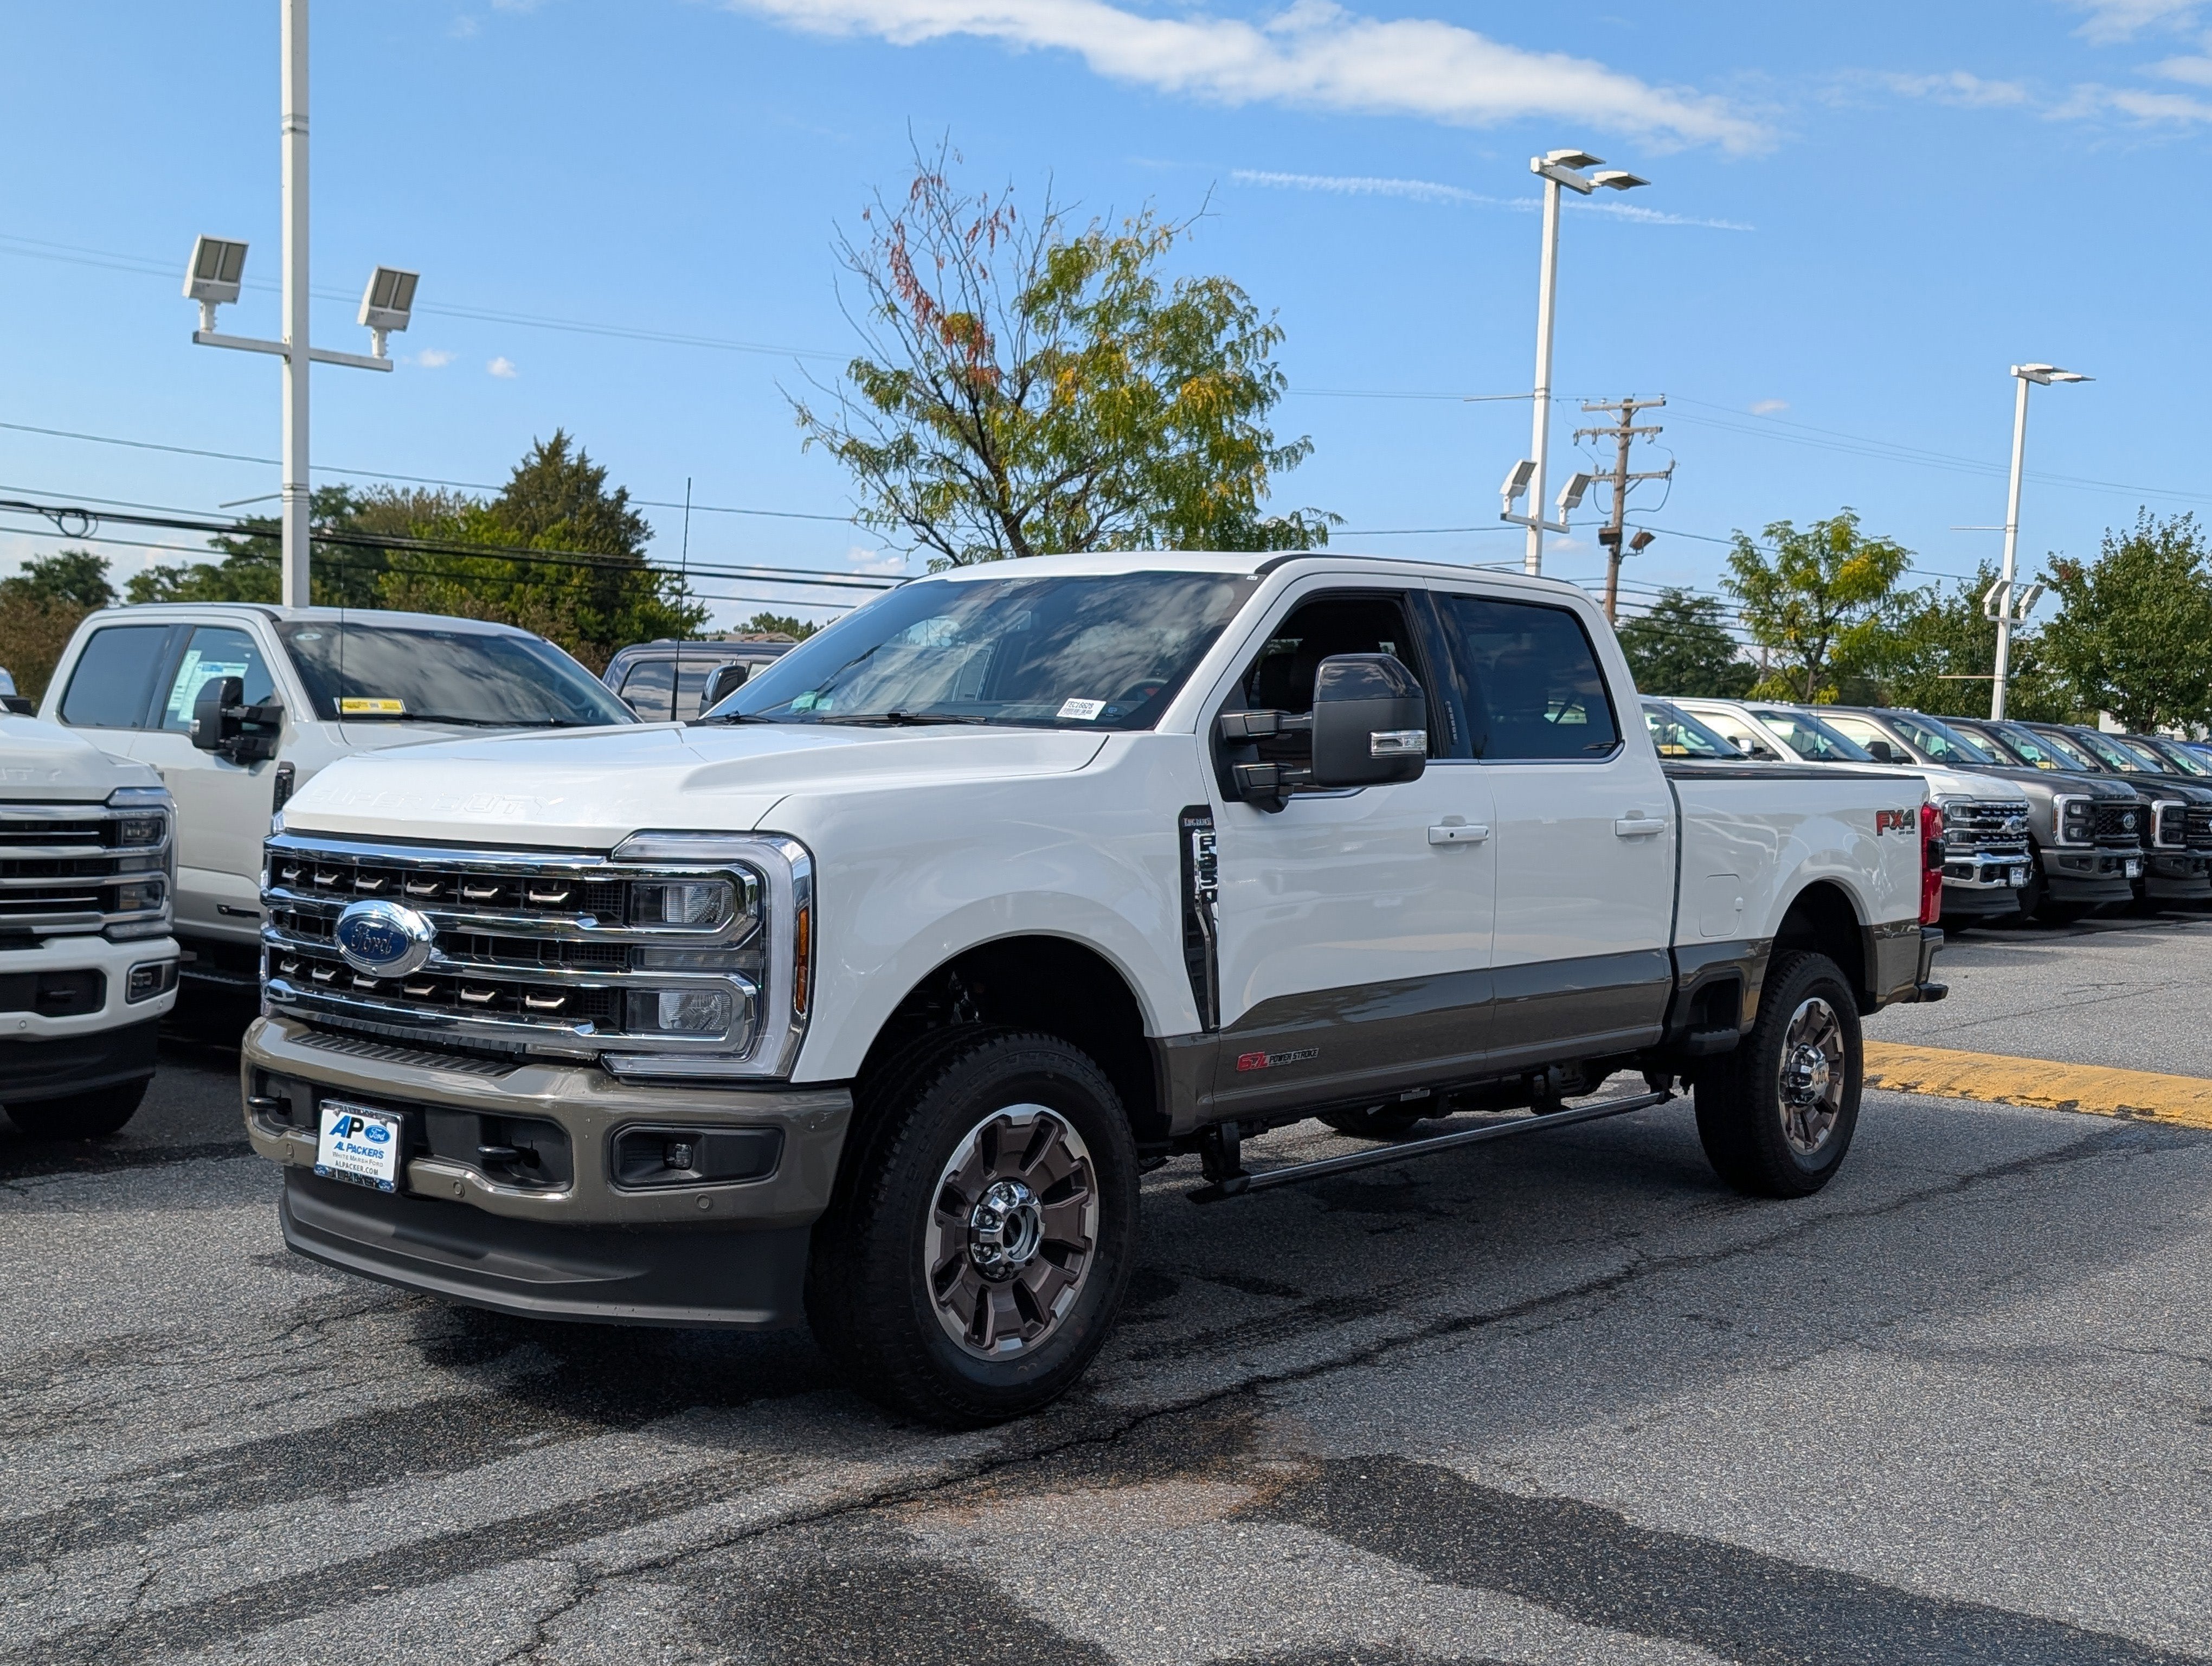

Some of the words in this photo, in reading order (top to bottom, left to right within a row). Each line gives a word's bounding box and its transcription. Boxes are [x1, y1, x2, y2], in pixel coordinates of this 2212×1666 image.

[1876, 809, 1915, 836] FX4
[351, 920, 393, 955] Ford
[1269, 1054, 1292, 1063] POWER
[329, 1115, 364, 1139] AP
[368, 1126, 387, 1141] Ford
[333, 1141, 345, 1151] AL
[346, 1143, 384, 1159] PACKER'S
[332, 1151, 349, 1160] WHITE
[350, 1155, 368, 1164] MARSH
[369, 1159, 383, 1168] FORD
[335, 1159, 378, 1176] ALPACKER.COM
